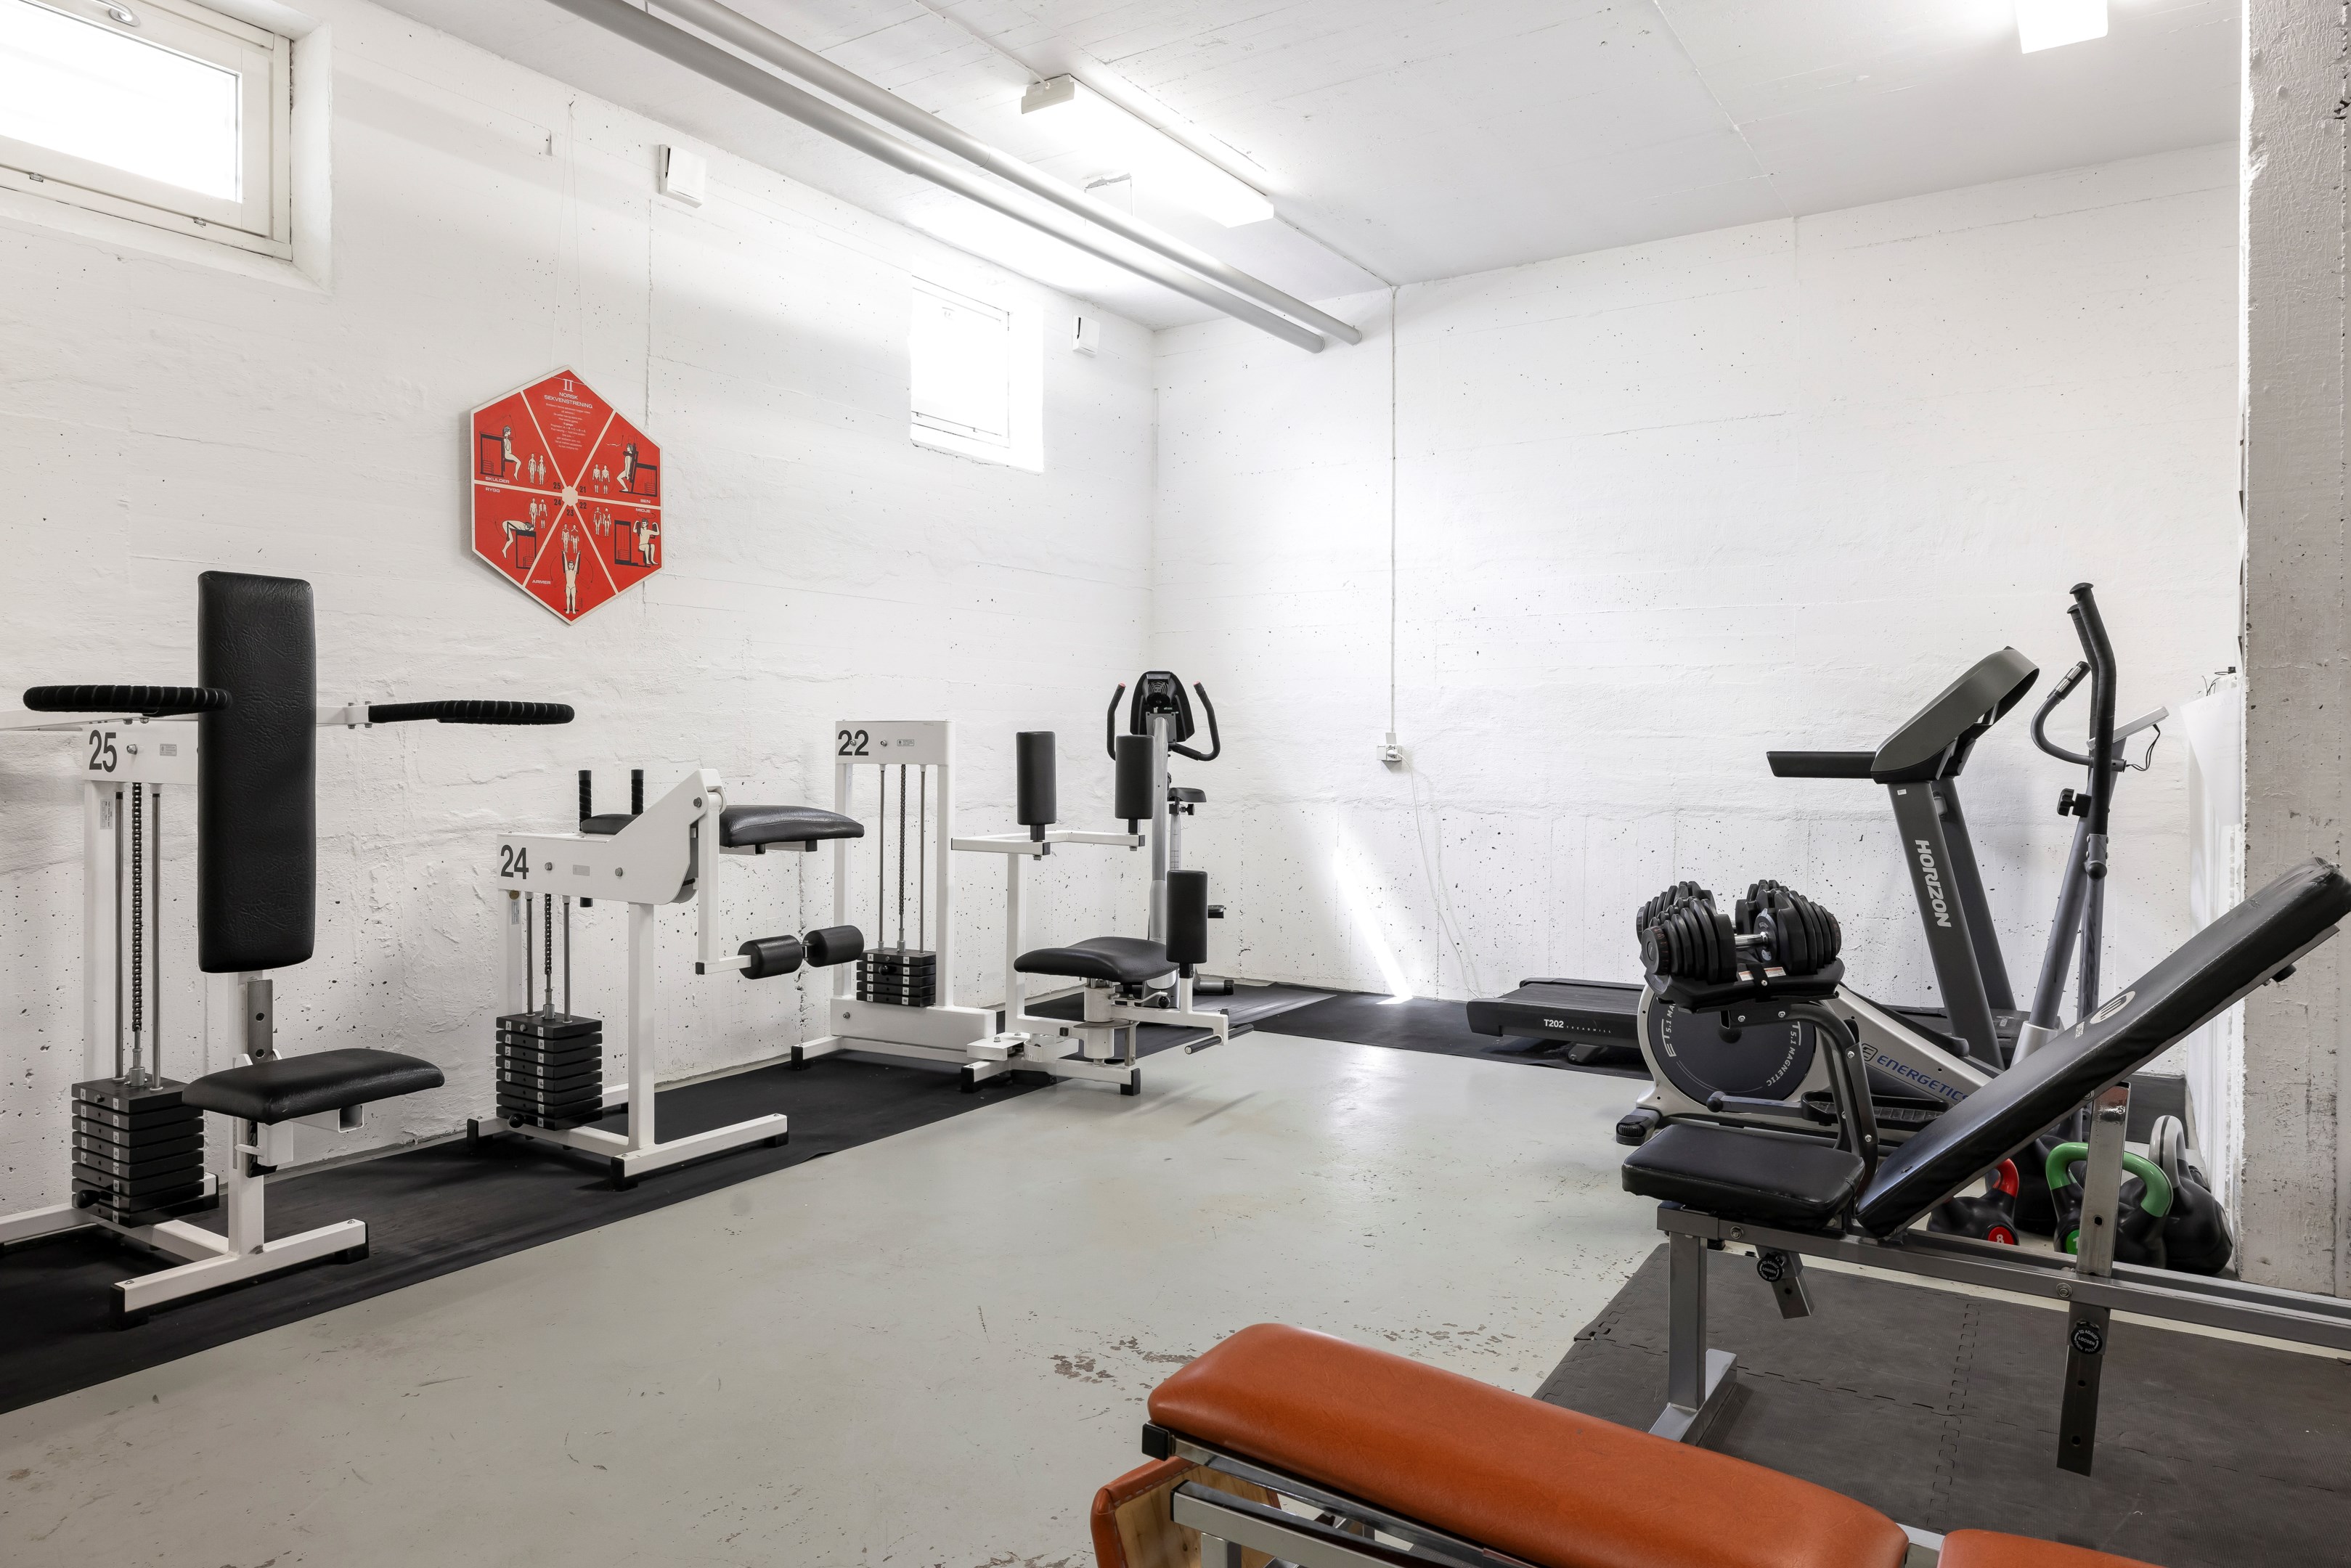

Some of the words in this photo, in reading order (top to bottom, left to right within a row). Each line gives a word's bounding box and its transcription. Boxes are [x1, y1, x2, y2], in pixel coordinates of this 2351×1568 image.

[544, 394, 593, 409] SEKVENSTRENING
[553, 481, 561, 490] 25
[838, 730, 869, 756] 22
[89, 730, 118, 772] 25
[500, 844, 529, 880] 24
[1915, 839, 1952, 927] HORIZON
[1544, 1019, 1564, 1028] T202
[1766, 1047, 1796, 1086] MAGNETIC
[1996, 1234, 2004, 1244] 8
[2073, 1236, 2079, 1249] 1
[2078, 1336, 2095, 1346] LOOSEN
[2085, 1330, 2098, 1340] ADJUST
